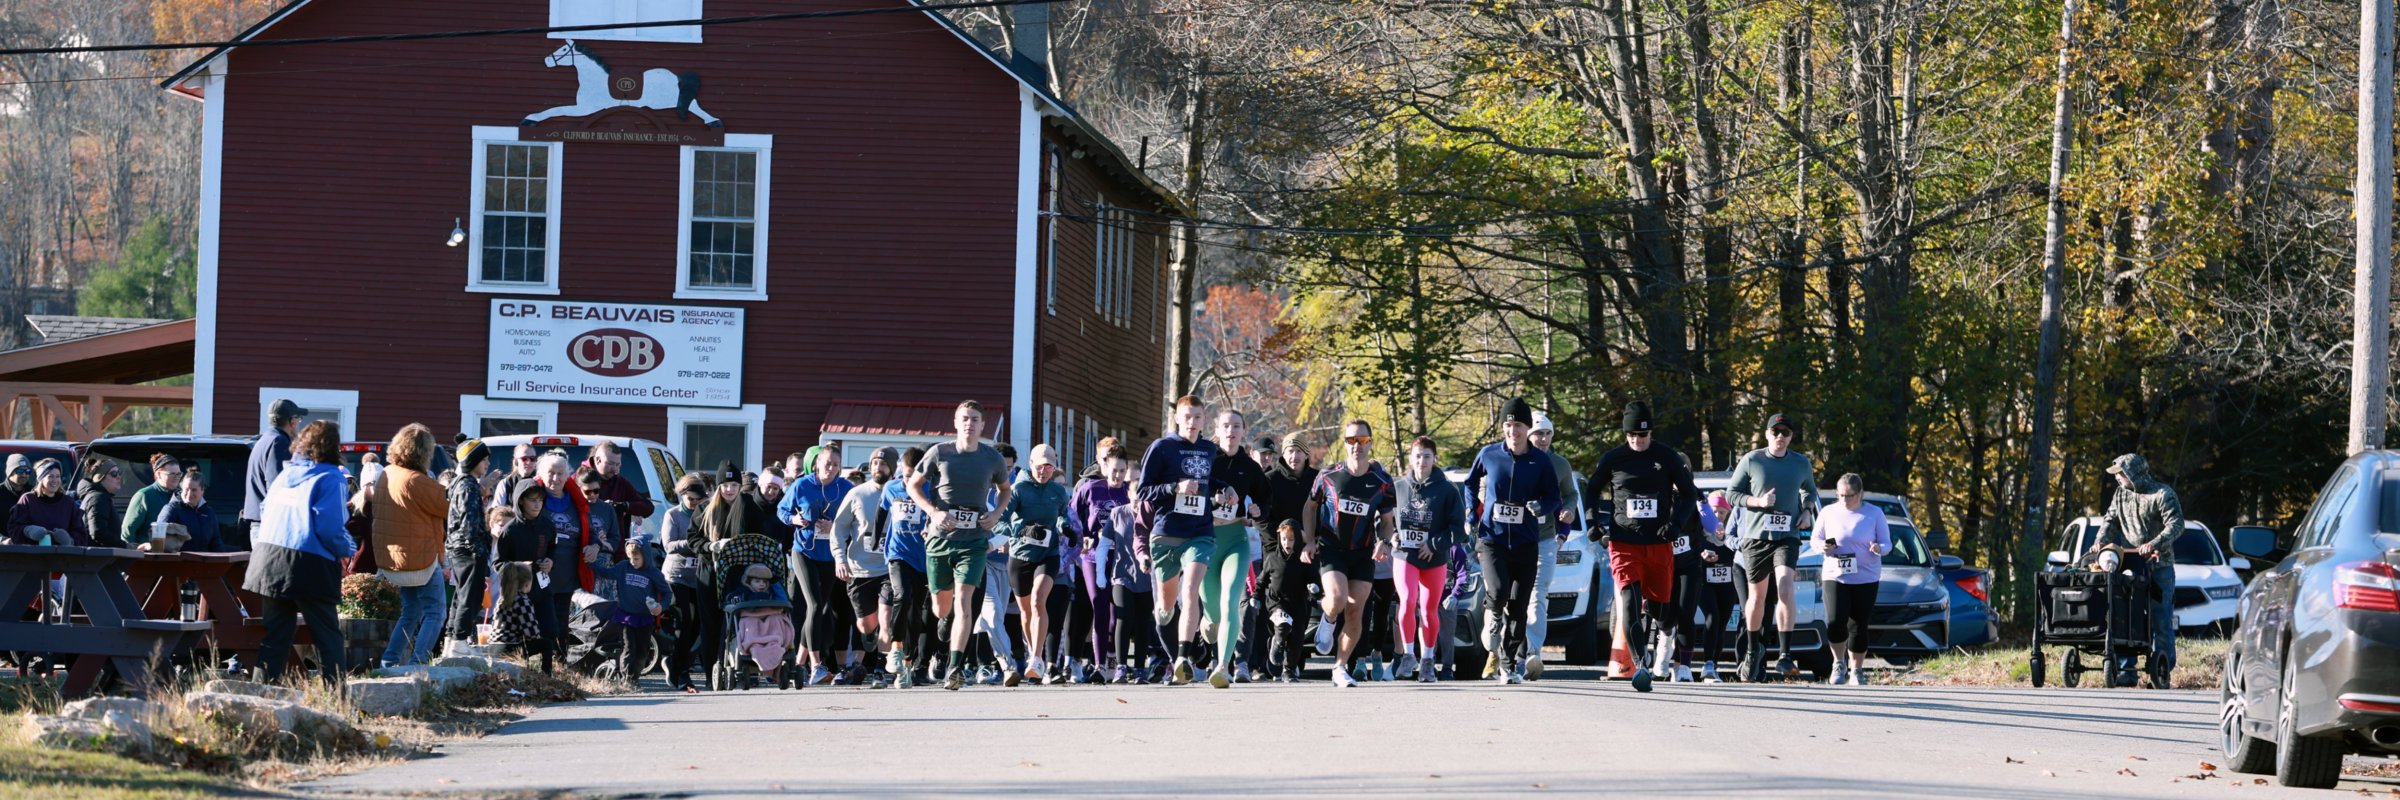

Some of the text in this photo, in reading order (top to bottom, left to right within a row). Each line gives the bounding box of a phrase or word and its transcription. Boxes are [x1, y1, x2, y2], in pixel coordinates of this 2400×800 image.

[563, 131, 590, 140] CLIFFORD
[596, 132, 622, 141] BEAUVAIS
[623, 132, 653, 142] INSURANCE
[499, 303, 675, 324] C.P. BEAUVAIS
[681, 310, 735, 319] INSURANCE
[681, 317, 721, 326] AGENCY
[505, 328, 551, 337] HOMEOWNERS
[689, 336, 722, 344] ANNUITIES
[573, 334, 656, 370] CPB
[698, 355, 710, 363] LIFE
[500, 363, 553, 372] 978-297-0472
[677, 370, 731, 379] 978-297-0222
[497, 379, 698, 399] Full Service Insurance Center
[1183, 495, 1199, 507] 111
[1632, 500, 1653, 511] 134
[899, 503, 916, 514] 133
[1344, 502, 1364, 514] 176
[1499, 505, 1519, 517] 135
[955, 511, 974, 522] 157
[1769, 515, 1787, 525] 182
[1405, 530, 1424, 541] 105
[1711, 567, 1728, 577] 152
